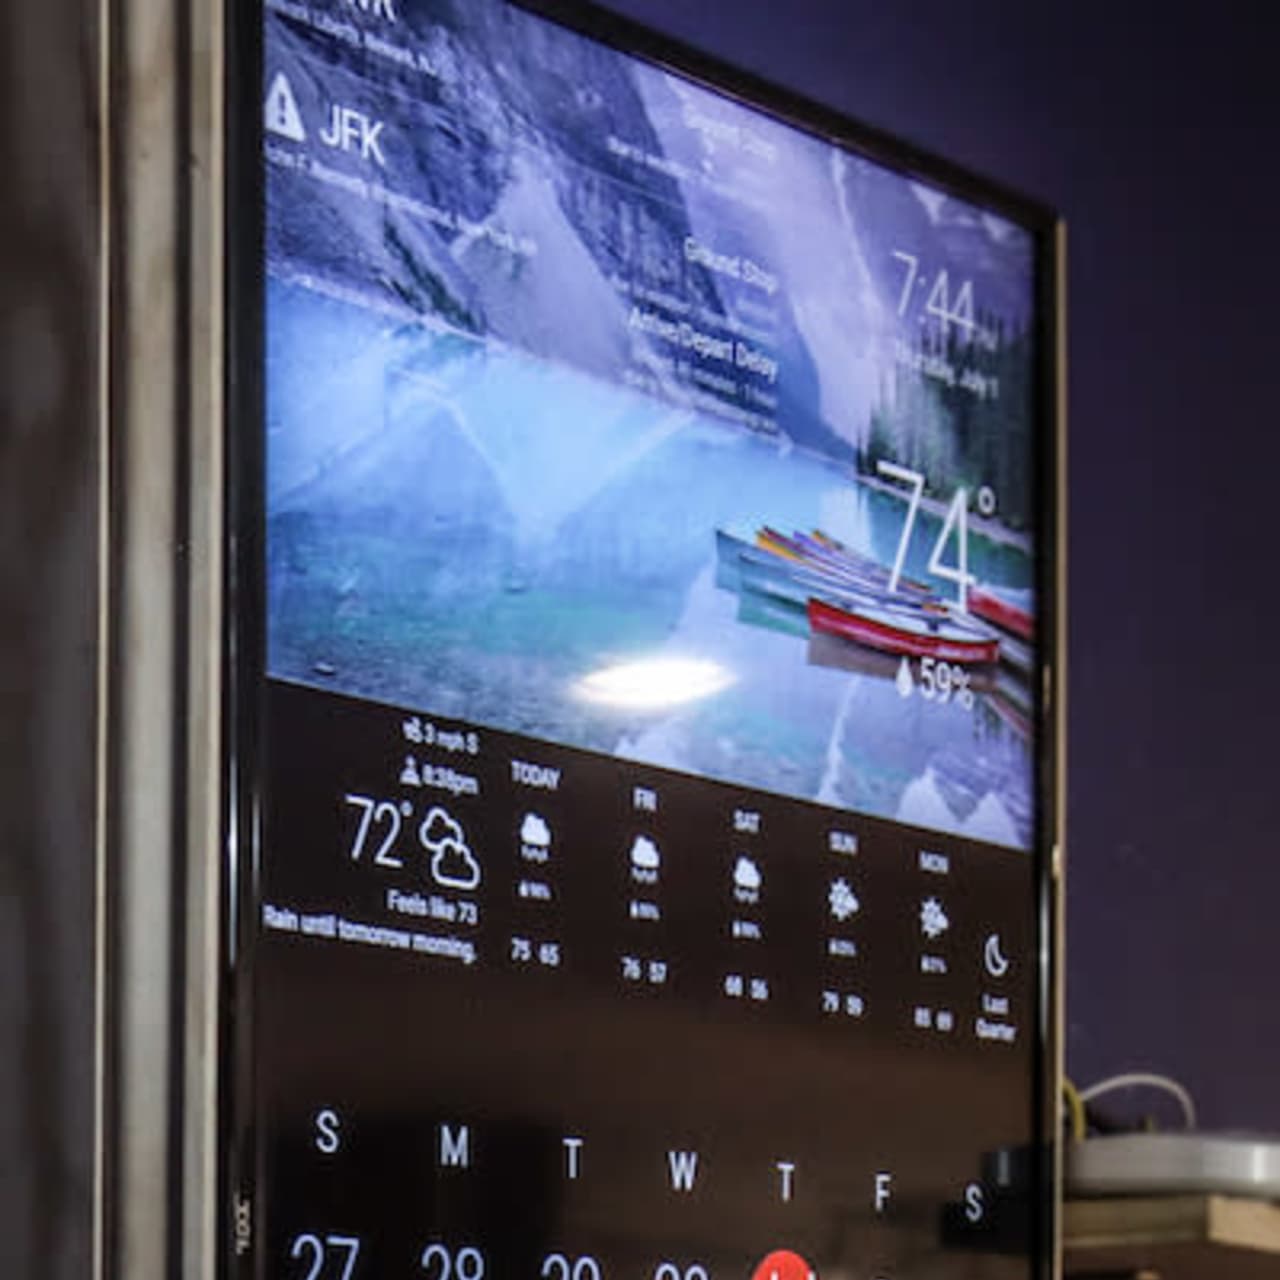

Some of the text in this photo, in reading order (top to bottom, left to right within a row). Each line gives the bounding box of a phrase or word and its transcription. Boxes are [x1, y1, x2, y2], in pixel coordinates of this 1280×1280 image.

[319, 103, 386, 166] JFK
[892, 250, 975, 346] 7:44
[919, 655, 975, 712] 59%
[511, 759, 561, 790] TODAY
[457, 900, 479, 925] 73
[316, 1110, 982, 1221] S M T W T F S
